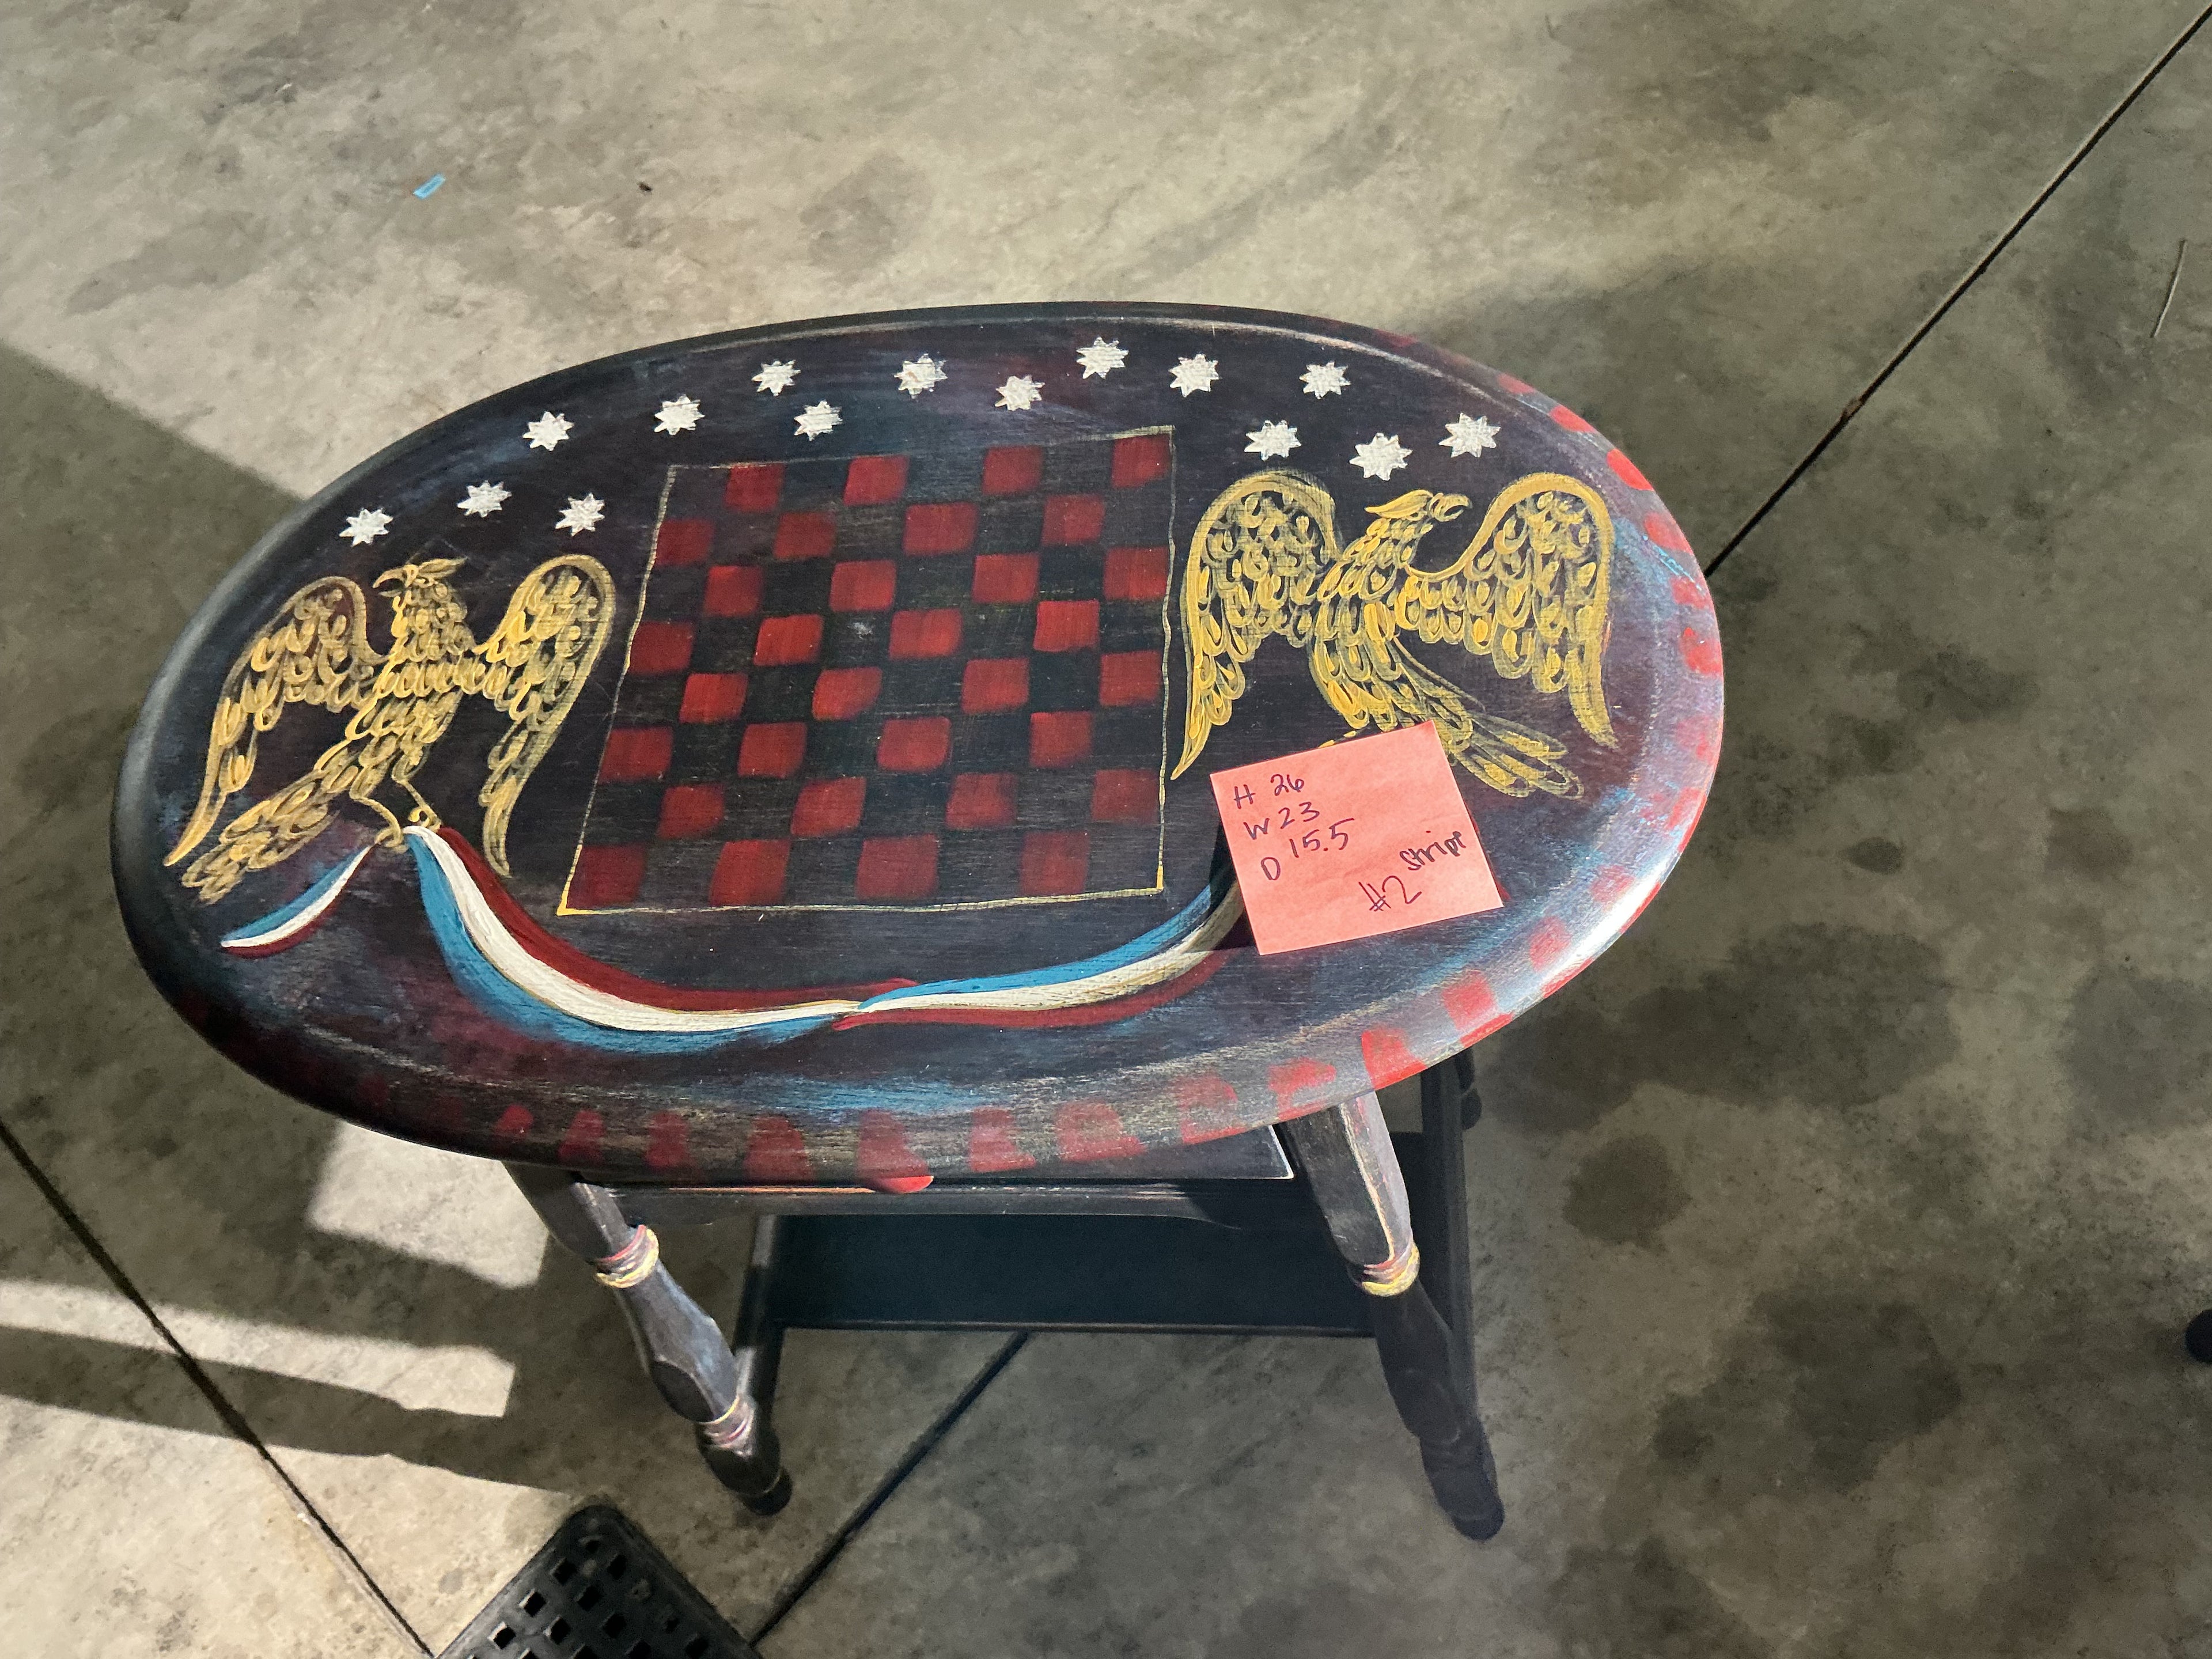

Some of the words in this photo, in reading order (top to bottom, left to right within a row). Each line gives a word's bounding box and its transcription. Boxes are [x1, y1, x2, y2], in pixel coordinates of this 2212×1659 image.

[1233, 784, 1256, 809] H
[1270, 774, 1304, 796] 26
[1278, 801, 1320, 830] 23
[1289, 817, 1355, 858] 15.5
[1358, 875, 1422, 911] #2
